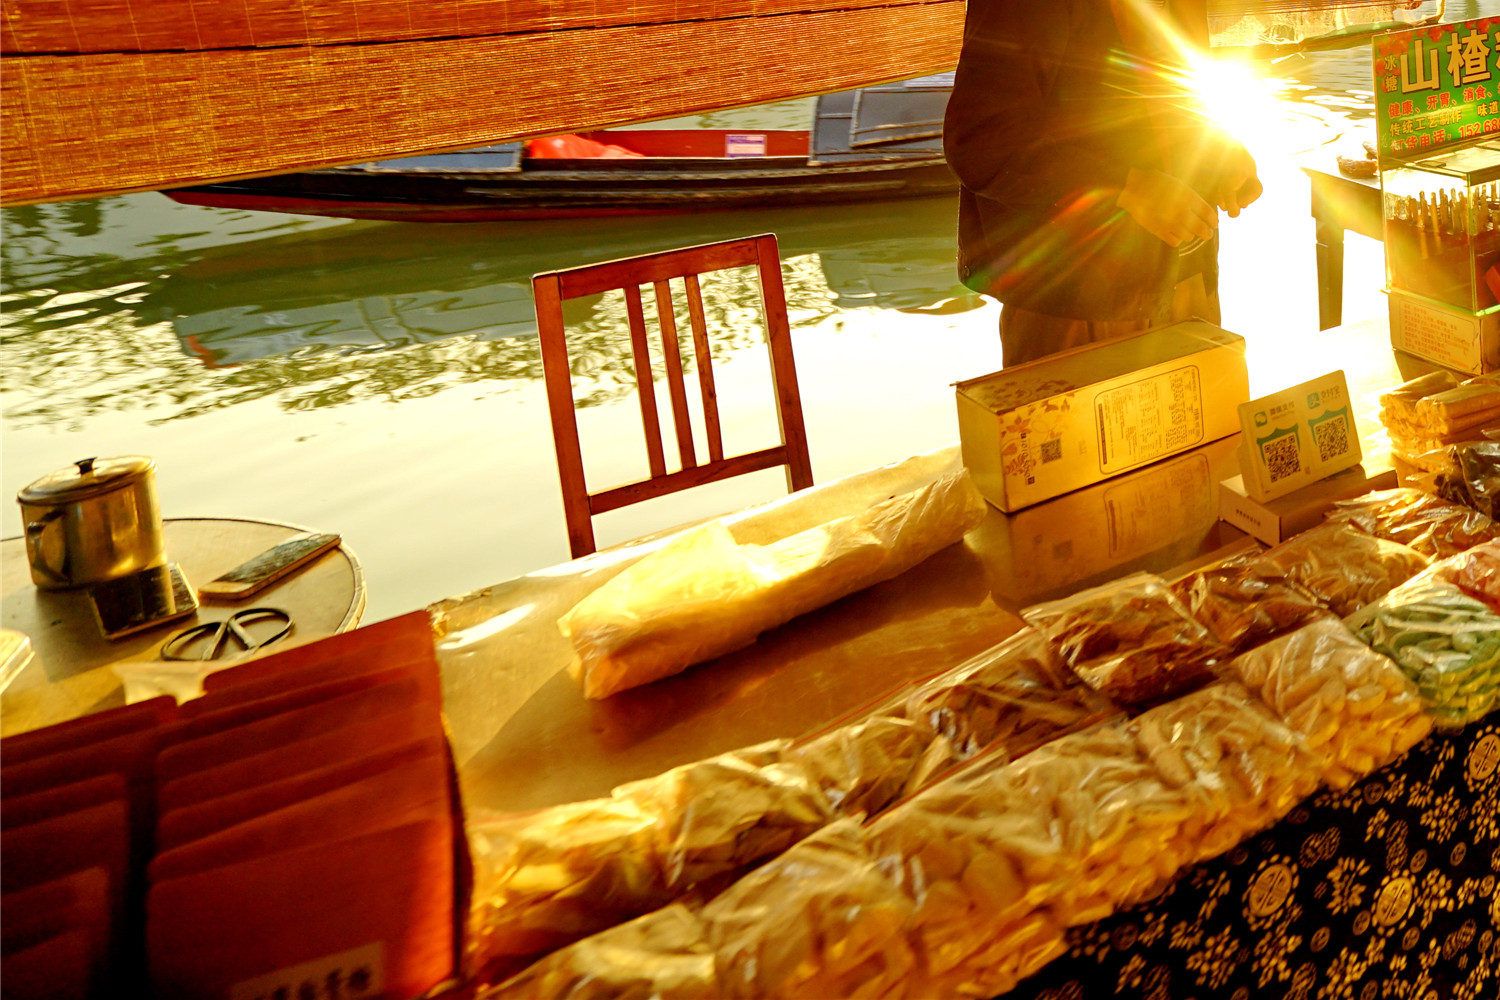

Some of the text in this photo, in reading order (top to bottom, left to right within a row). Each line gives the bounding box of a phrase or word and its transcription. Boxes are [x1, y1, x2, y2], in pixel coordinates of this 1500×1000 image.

[1384, 55, 1398, 92] 冰糖
[1390, 110, 1462, 137] 传统工艺制作
[1459, 122, 1481, 138] 152
